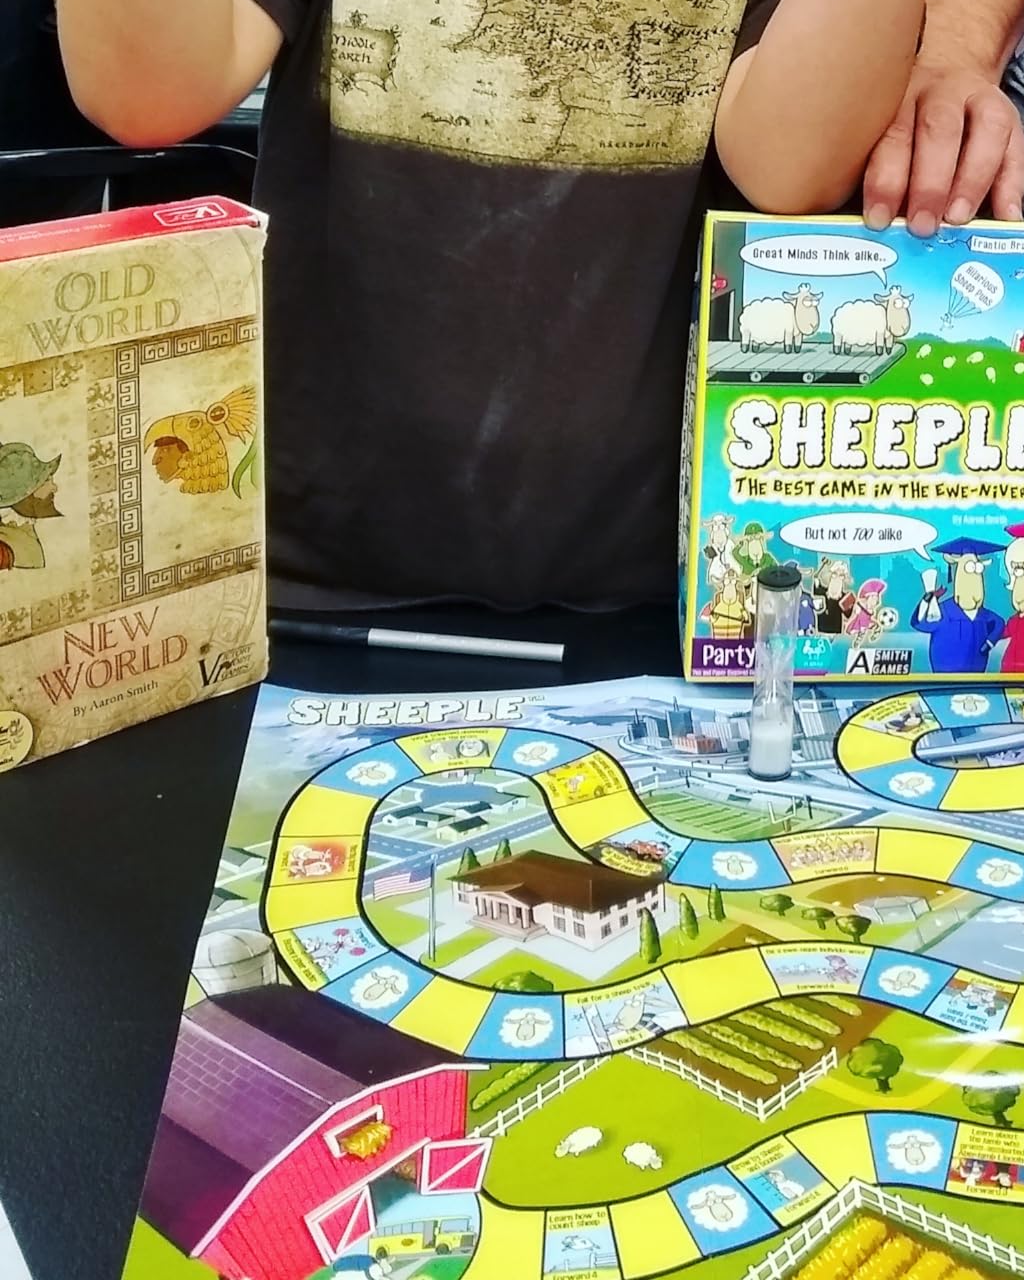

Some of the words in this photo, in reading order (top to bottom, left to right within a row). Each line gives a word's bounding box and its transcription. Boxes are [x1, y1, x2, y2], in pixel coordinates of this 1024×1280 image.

[753, 248, 783, 259] Great
[787, 248, 819, 261] Minds
[822, 250, 850, 261] Think
[54, 263, 156, 314] OLD
[954, 273, 976, 293] Sheep
[27, 298, 182, 357] WORLD
[735, 477, 768, 496] THE
[773, 480, 815, 497] BEST
[820, 481, 867, 498] GAME
[898, 480, 930, 499] THE
[804, 527, 823, 540] But
[828, 529, 847, 540] not
[878, 528, 903, 540] alike
[63, 606, 160, 665] NEW
[703, 644, 756, 668] Party
[849, 651, 871, 674] A
[874, 650, 908, 661] SMITH
[37, 634, 188, 706] WORLD
[872, 663, 910, 675] GAMES
[73, 705, 88, 717] By
[90, 692, 124, 710] Aaron
[126, 680, 158, 698] Smith
[287, 696, 527, 727] SHEEPLE
